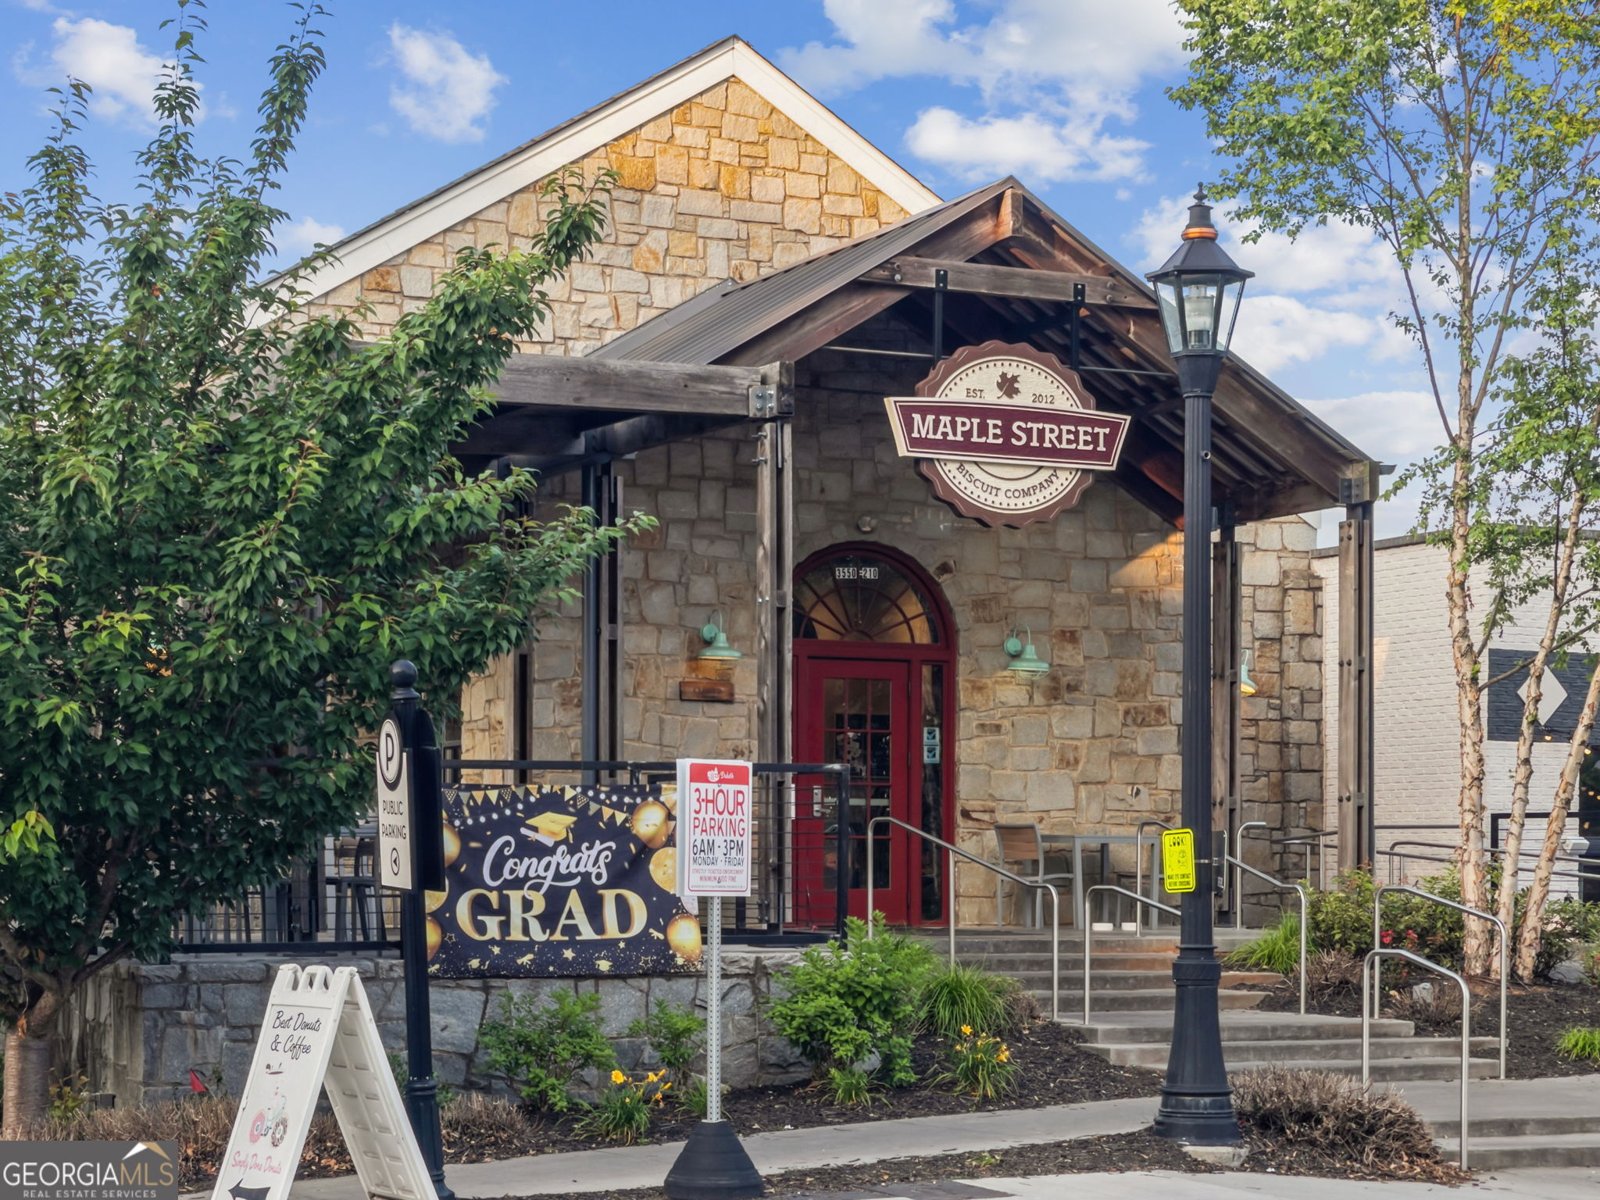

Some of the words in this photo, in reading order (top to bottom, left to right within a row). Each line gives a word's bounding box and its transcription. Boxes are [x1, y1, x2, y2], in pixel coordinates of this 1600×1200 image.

[965, 387, 986, 400] EST.
[1031, 393, 1055, 405] 2012
[911, 413, 1004, 444] MAPLE
[1010, 421, 1111, 452] STREET
[956, 462, 1002, 498] BISCUIT
[1004, 469, 1060, 499] COMPANY
[385, 732, 395, 771] P
[382, 799, 403, 816] PUBLIC
[693, 787, 745, 817] 3-HOUR
[381, 824, 407, 840] PARKING
[693, 816, 745, 837] PARKING
[692, 838, 715, 856] 6AM
[723, 839, 744, 857] 3PM
[482, 835, 616, 900] Congrats
[692, 856, 718, 866] MONDAY
[724, 857, 745, 867] FRIDAY
[455, 888, 648, 942] GRAD
[272, 1010, 293, 1029] Best
[293, 1012, 322, 1032] Donuts
[270, 1034, 282, 1052] &
[283, 1034, 312, 1060] Coffee
